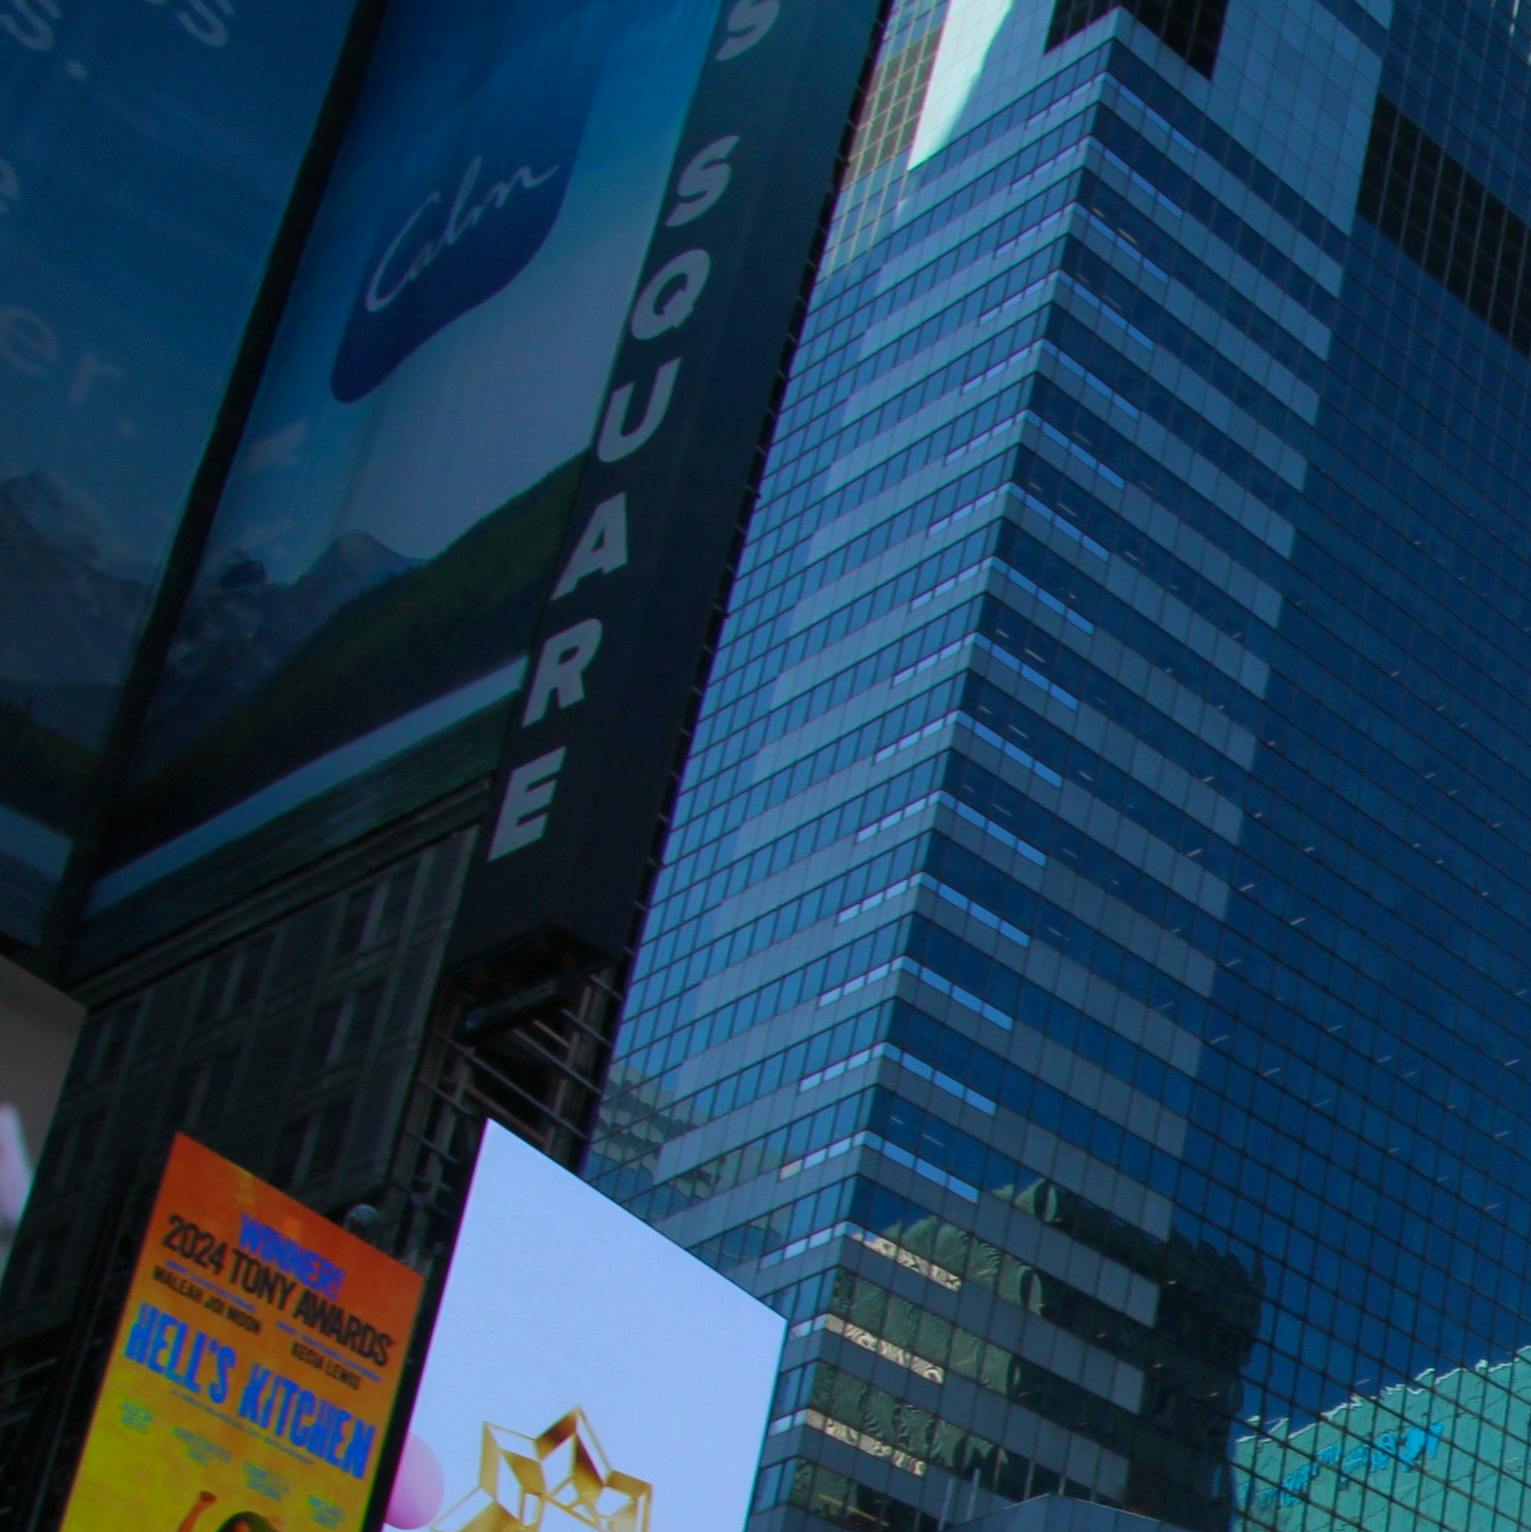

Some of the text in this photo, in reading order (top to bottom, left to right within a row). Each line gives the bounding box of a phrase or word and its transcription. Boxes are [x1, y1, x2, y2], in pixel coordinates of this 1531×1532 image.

[487, 134, 740, 862] SQUARE
[162, 1214, 228, 1275] 2024
[229, 1248, 298, 1311] TONY
[292, 1288, 395, 1367] AWARDS
[124, 1301, 237, 1404] HELL'S
[239, 1360, 377, 1480] KITCHEN
